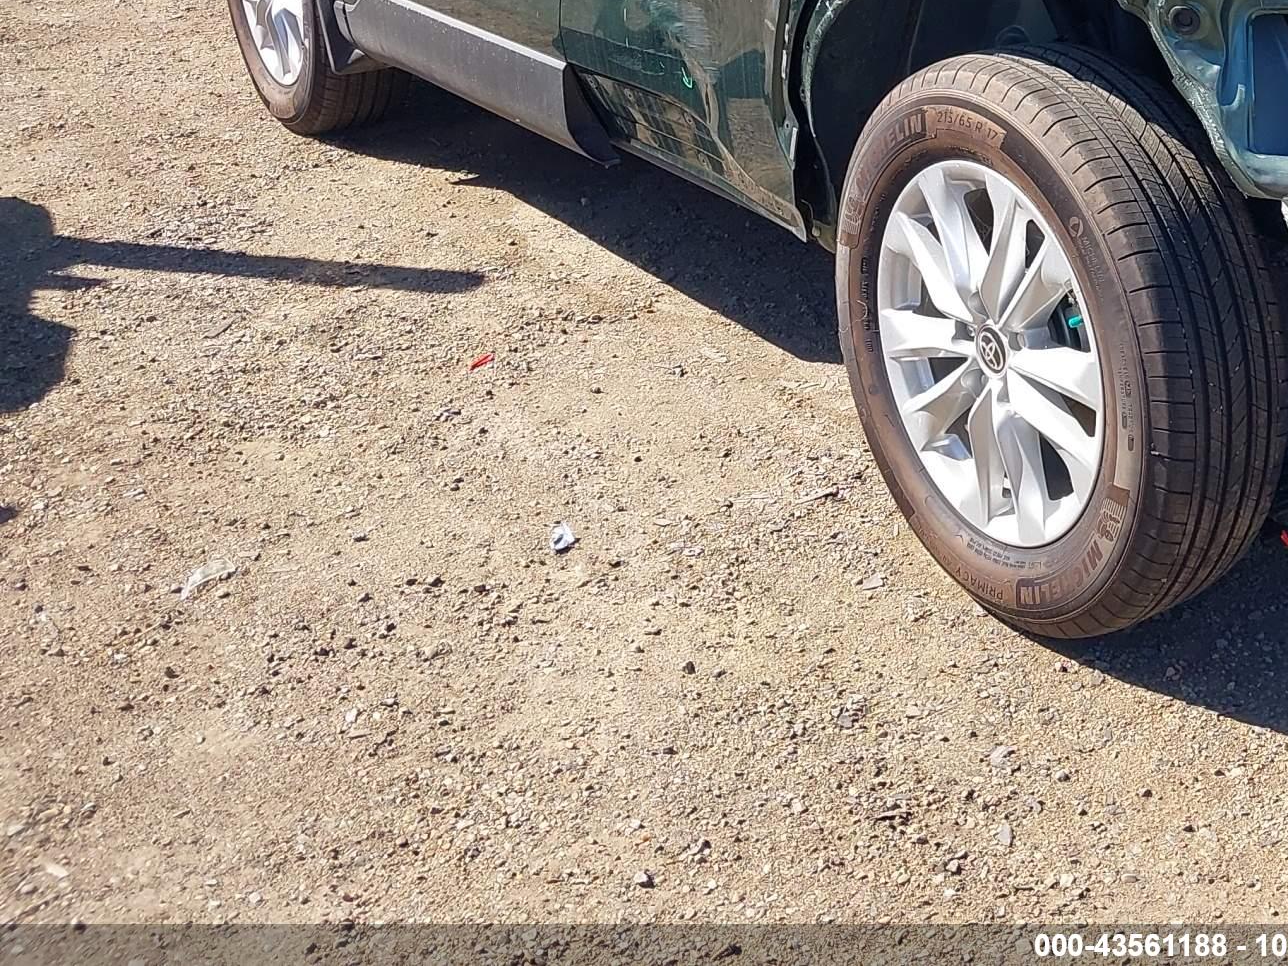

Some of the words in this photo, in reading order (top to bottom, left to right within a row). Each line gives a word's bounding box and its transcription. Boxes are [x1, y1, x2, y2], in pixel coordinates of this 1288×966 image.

[937, 111, 974, 129] 215/65
[974, 121, 983, 133] R
[986, 127, 999, 141] 17
